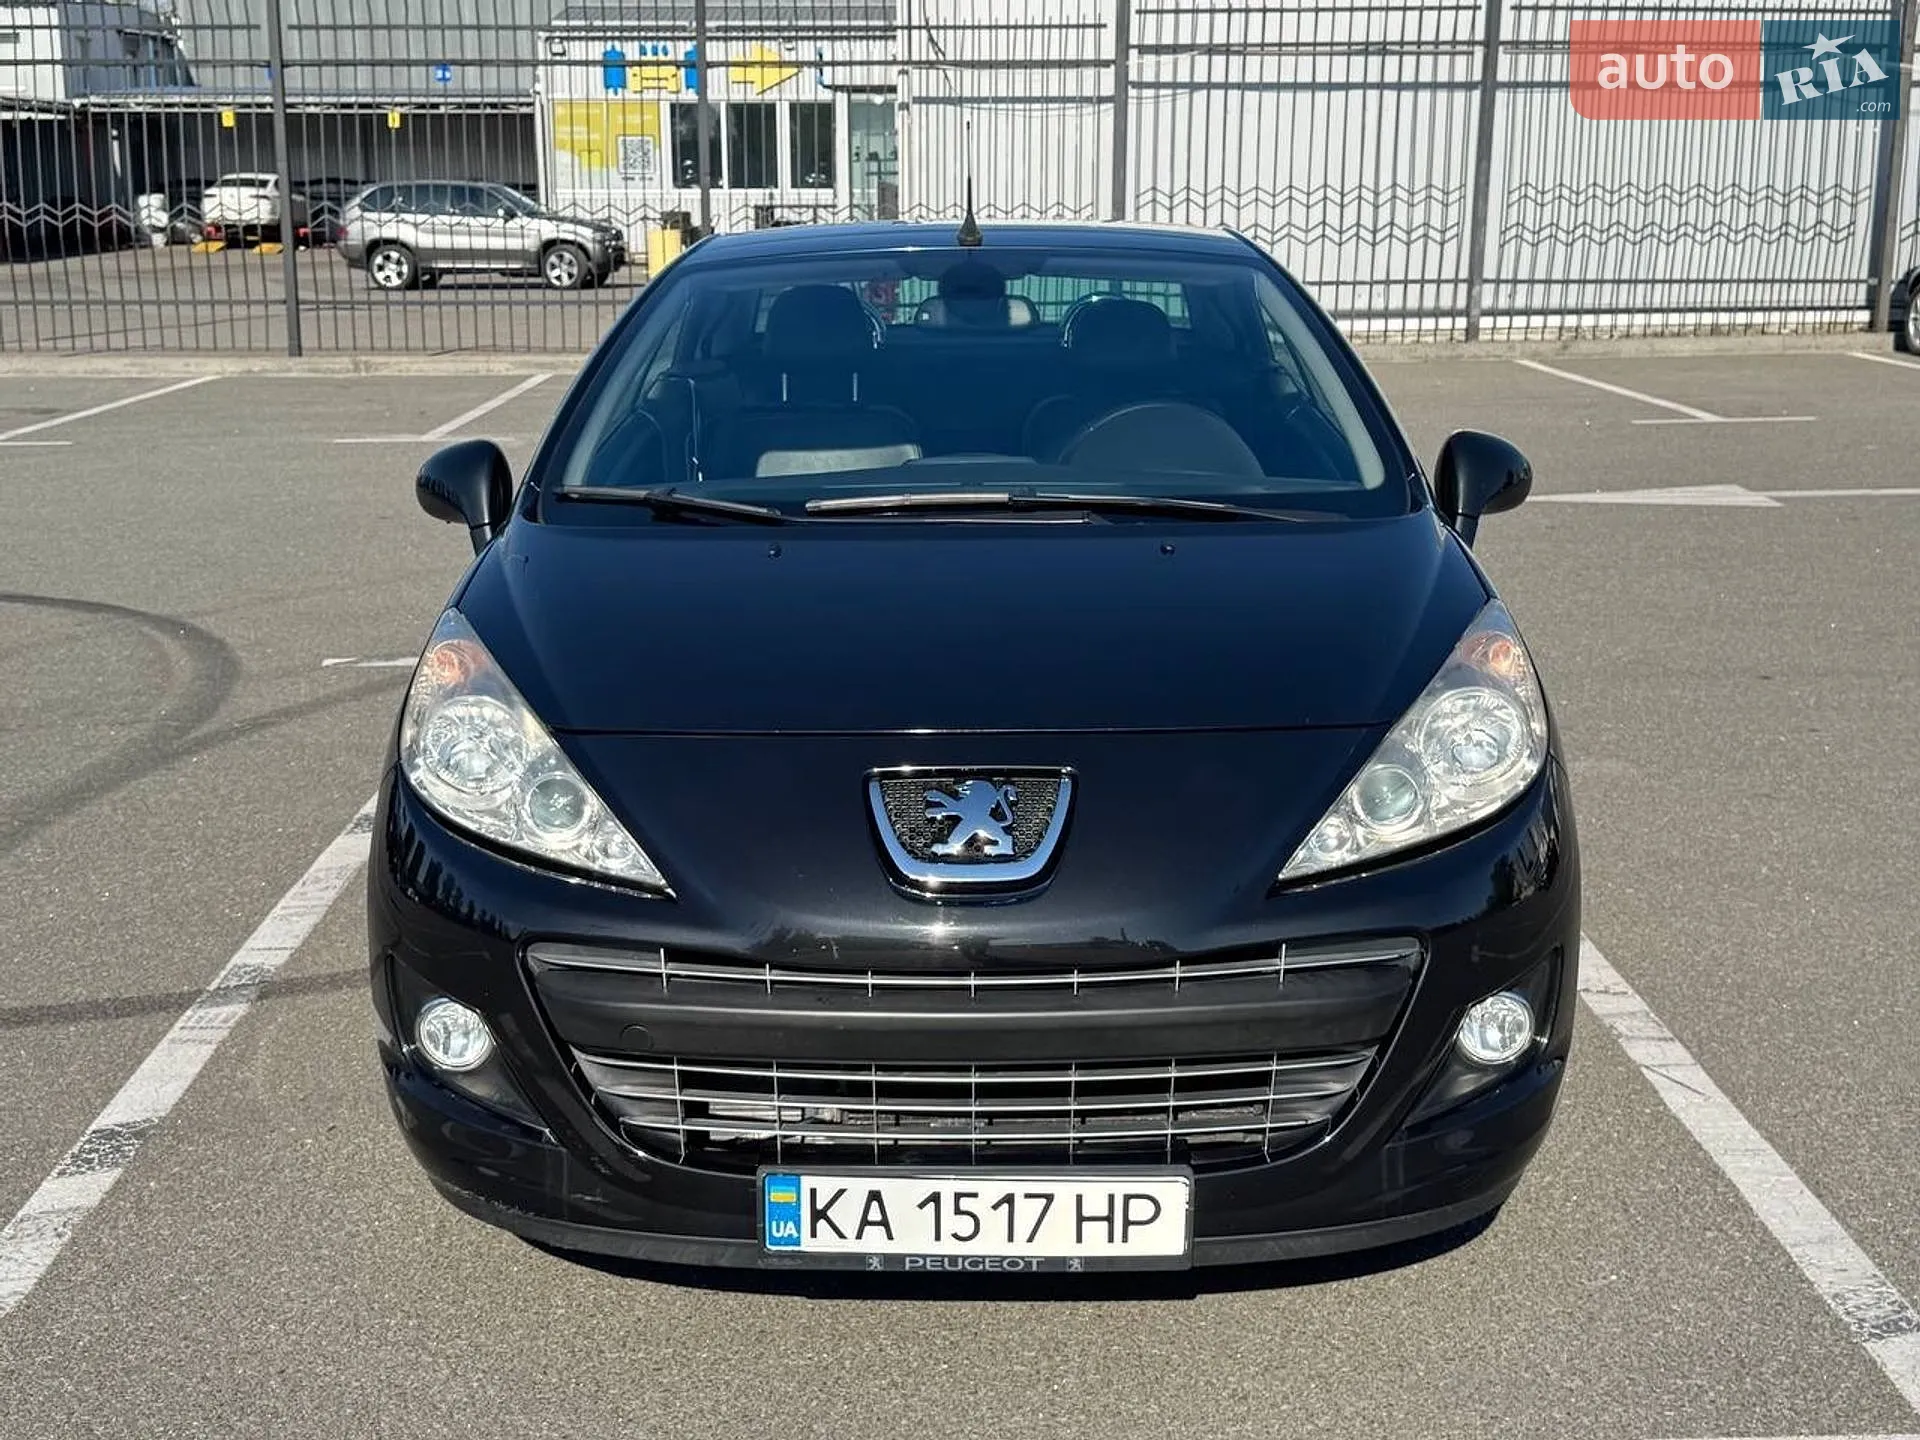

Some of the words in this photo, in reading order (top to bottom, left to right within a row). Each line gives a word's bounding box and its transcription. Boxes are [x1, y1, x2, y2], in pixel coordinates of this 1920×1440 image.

[809, 1188, 895, 1241] KA
[916, 1191, 1055, 1243] 1517
[1075, 1193, 1162, 1244] HP
[771, 1221, 799, 1239] UA
[905, 1257, 1044, 1272] PEUGEOT
